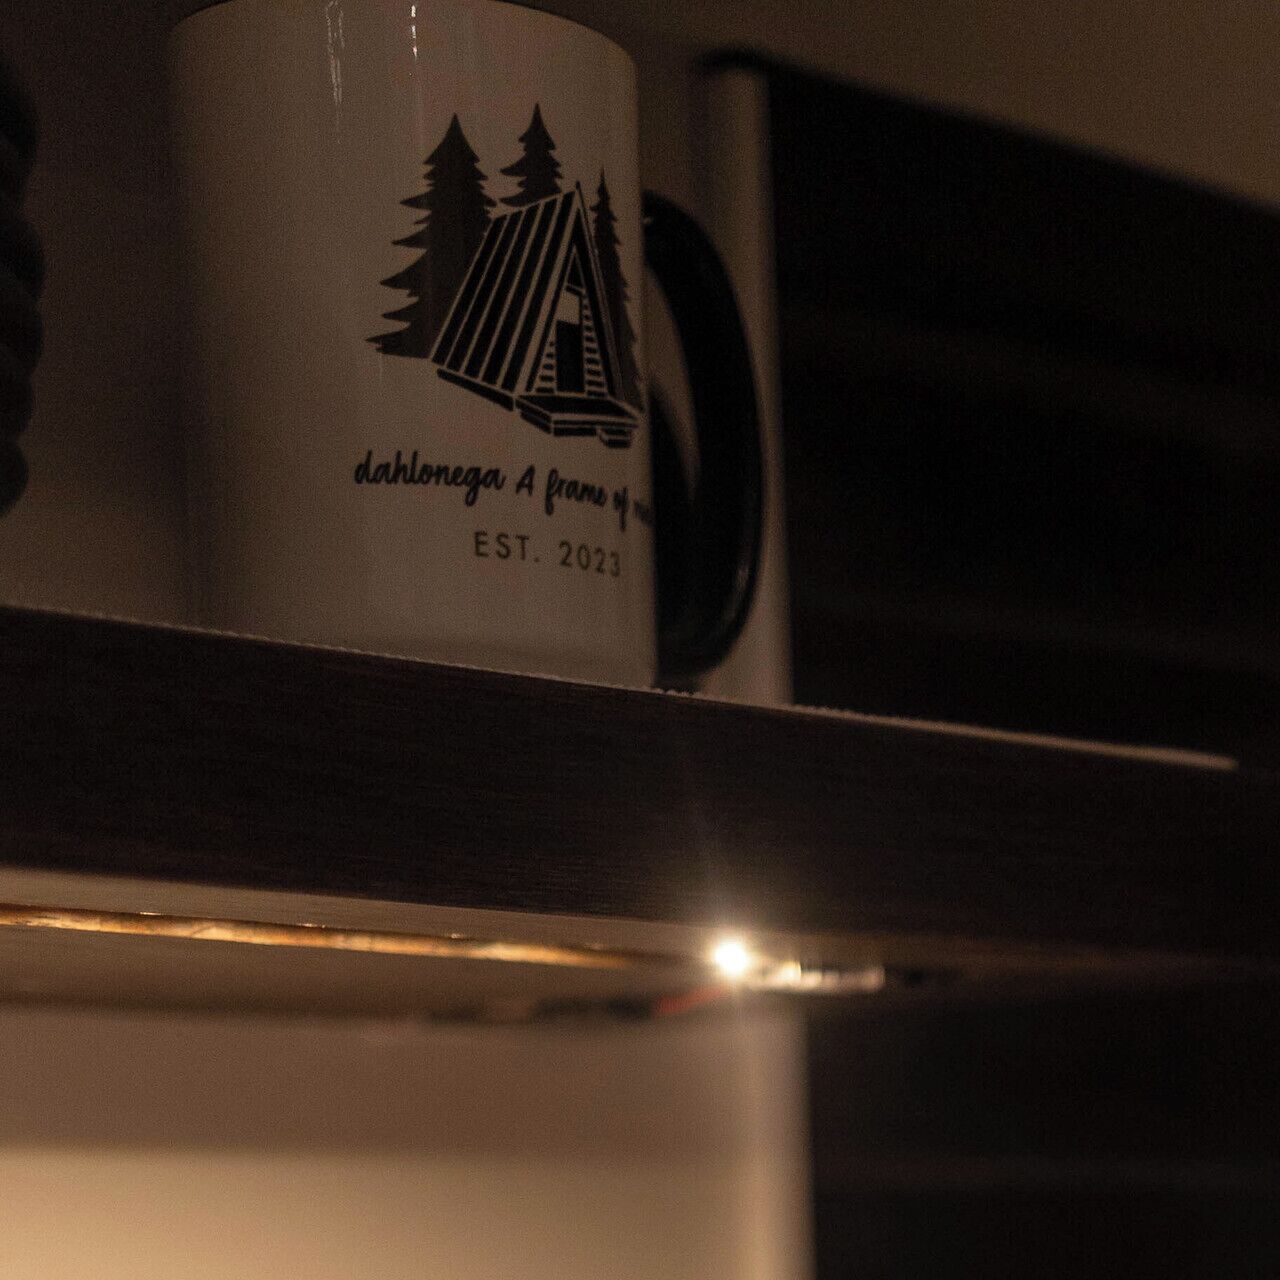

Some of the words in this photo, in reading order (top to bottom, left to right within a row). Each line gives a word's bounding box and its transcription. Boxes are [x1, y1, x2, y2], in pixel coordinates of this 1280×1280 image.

[354, 450, 506, 507] dahlonega
[515, 465, 535, 497] A
[545, 467, 608, 516] frame
[474, 530, 540, 563] EST.
[559, 540, 622, 578] 2023
